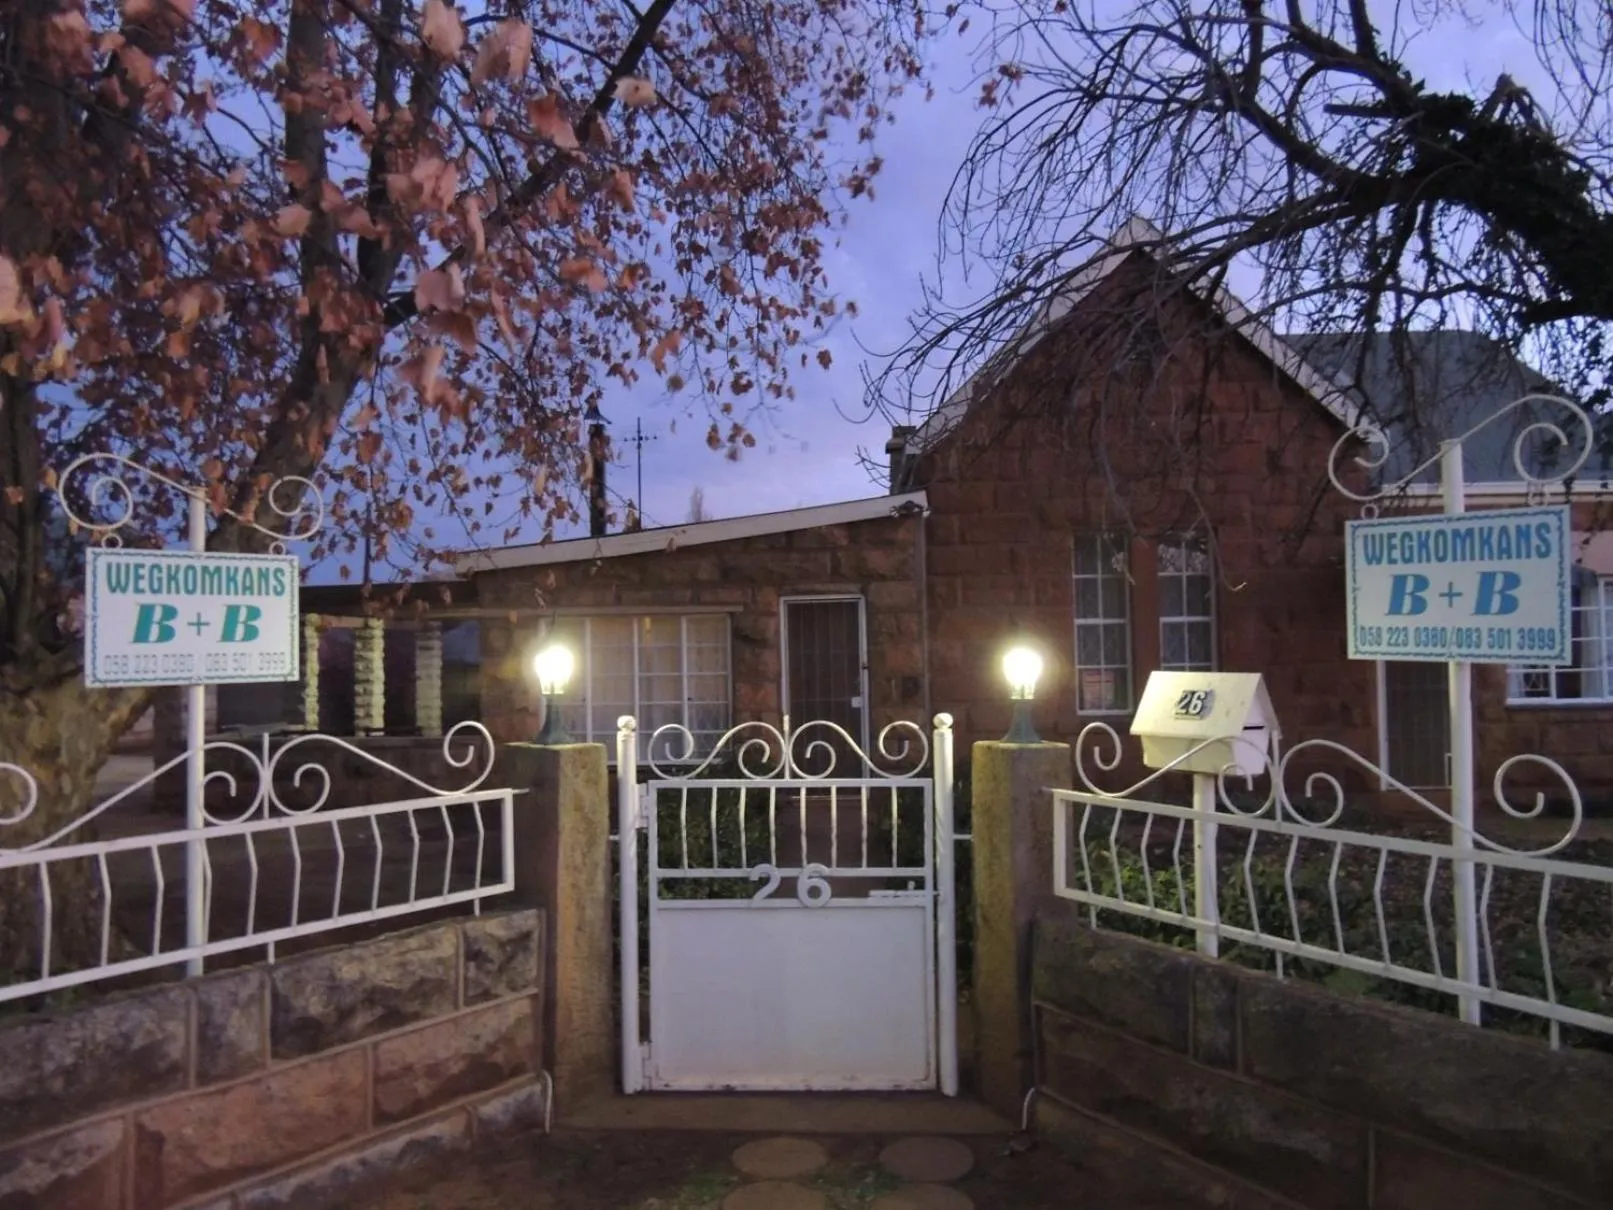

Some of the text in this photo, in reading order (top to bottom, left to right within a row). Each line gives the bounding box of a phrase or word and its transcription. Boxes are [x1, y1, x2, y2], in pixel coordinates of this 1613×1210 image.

[1363, 522, 1552, 566] WEGKOMKANS
[106, 562, 286, 597] WEGKOMKANS
[1360, 625, 1383, 647] 058
[1386, 626, 1409, 647] 223
[1487, 627, 1512, 649] 501
[1517, 627, 1556, 650] 3999
[1177, 690, 1206, 715] 26
[749, 863, 832, 908] 26
